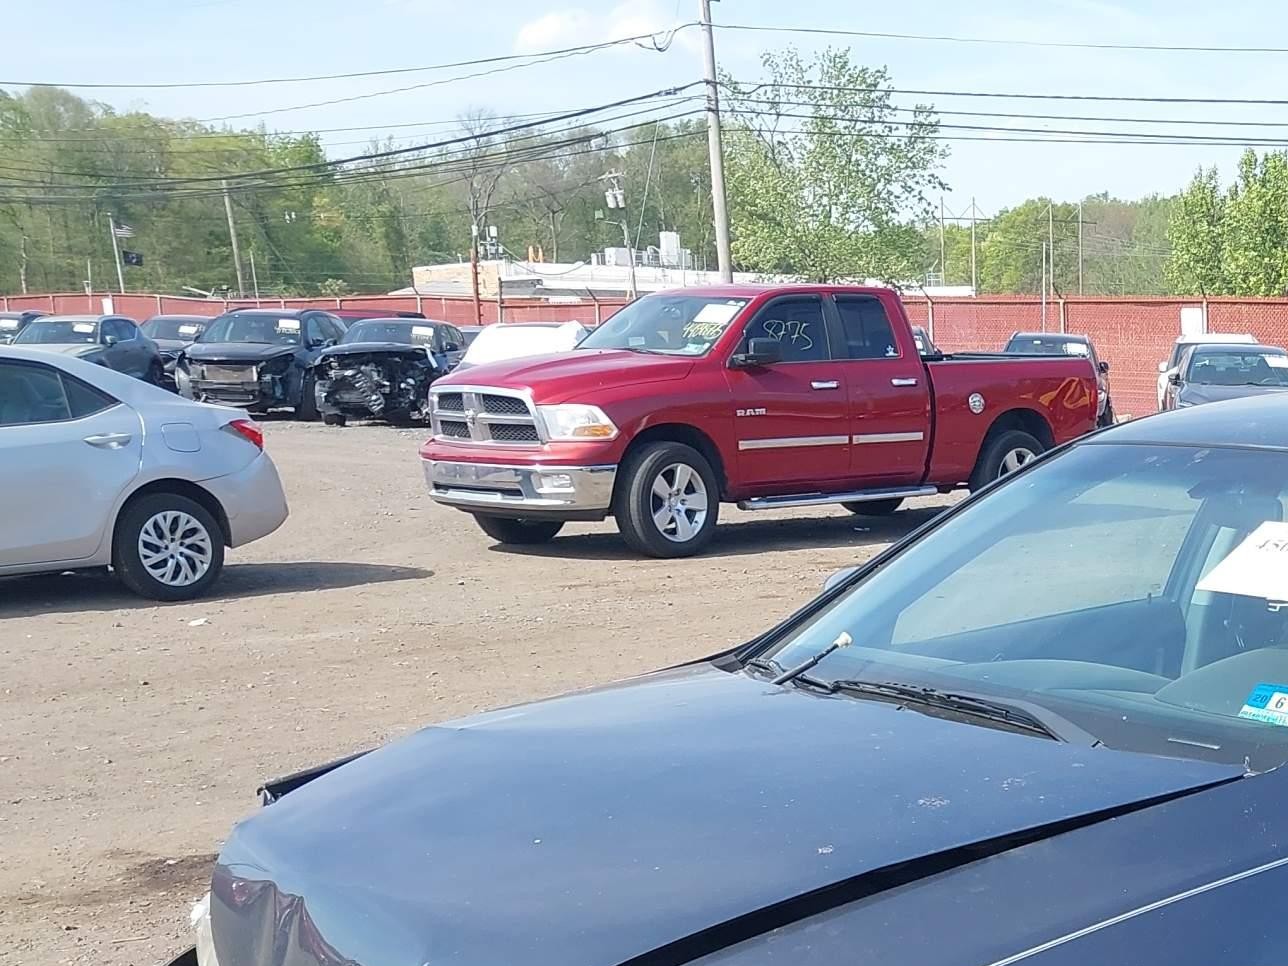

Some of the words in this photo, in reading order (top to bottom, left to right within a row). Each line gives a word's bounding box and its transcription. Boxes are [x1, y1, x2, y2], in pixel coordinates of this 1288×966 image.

[763, 319, 813, 350] 8775
[736, 408, 767, 417] RAM
[1253, 694, 1268, 703] 20
[1275, 696, 1286, 709] 6
